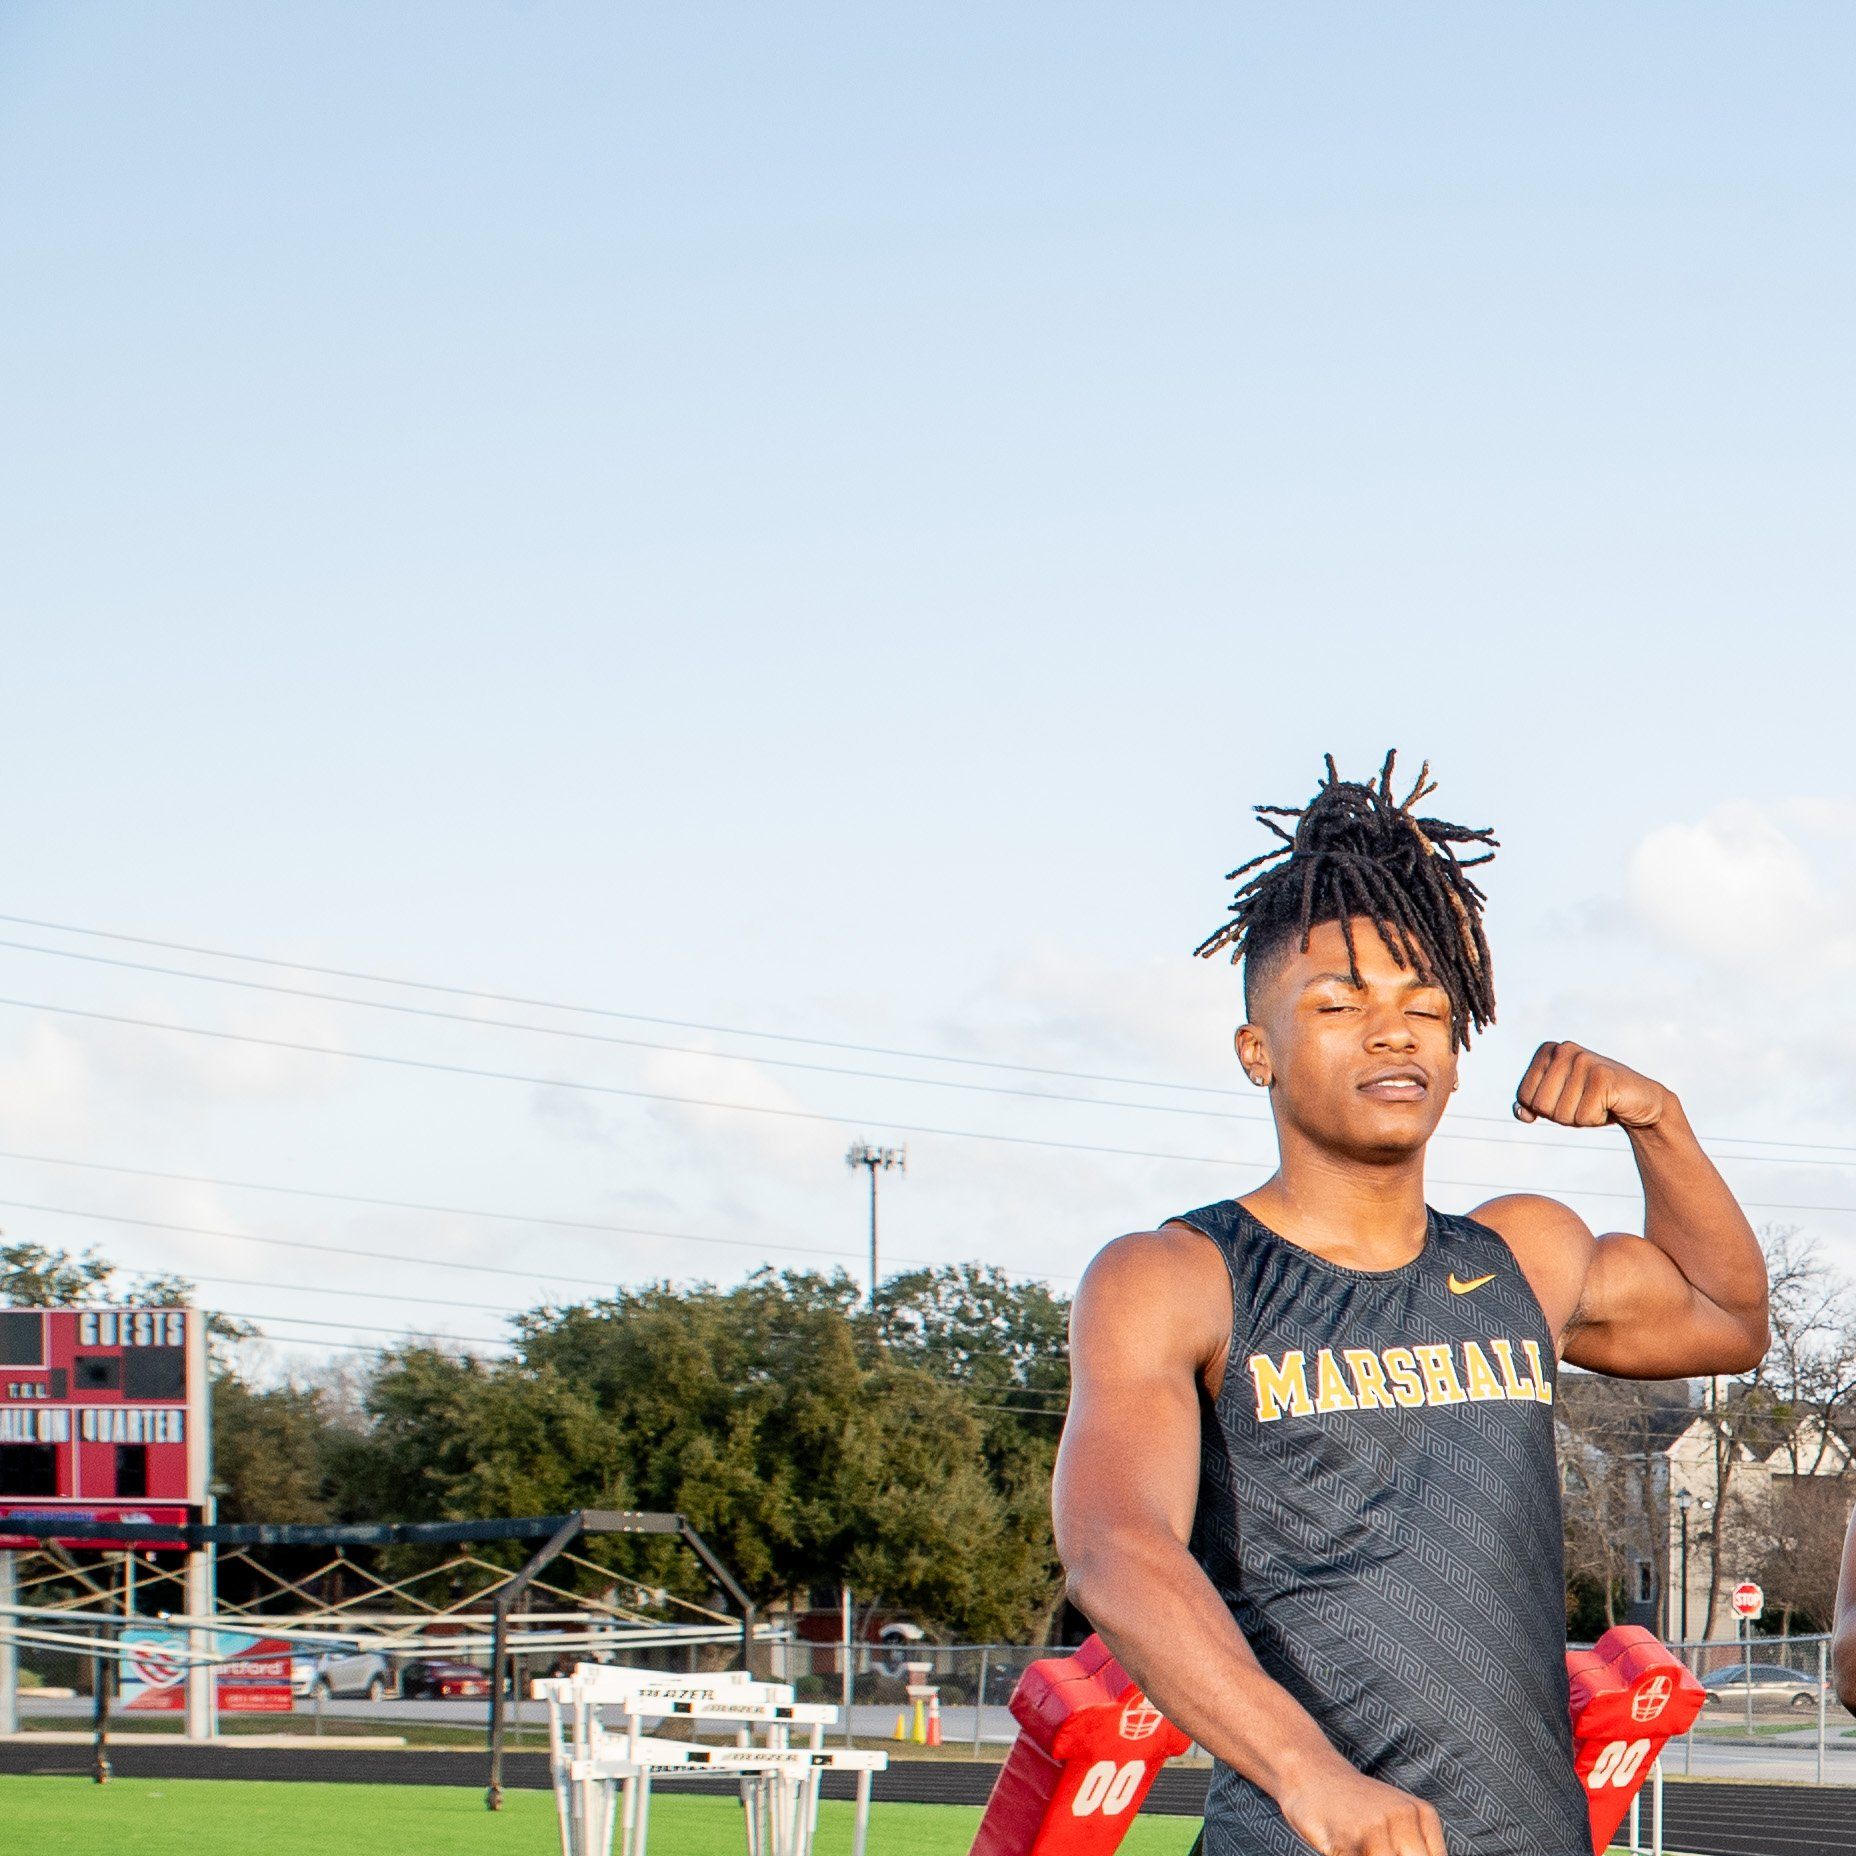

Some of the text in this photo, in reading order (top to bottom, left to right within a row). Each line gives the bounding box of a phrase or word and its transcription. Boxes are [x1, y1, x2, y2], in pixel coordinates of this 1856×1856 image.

[80, 1313, 184, 1346] GUESTS
[1249, 1339, 1553, 1423] MARSHALL
[1736, 1593, 1760, 1606] STOP
[1072, 1760, 1146, 1817] 00
[1587, 1738, 1651, 1789] 00
